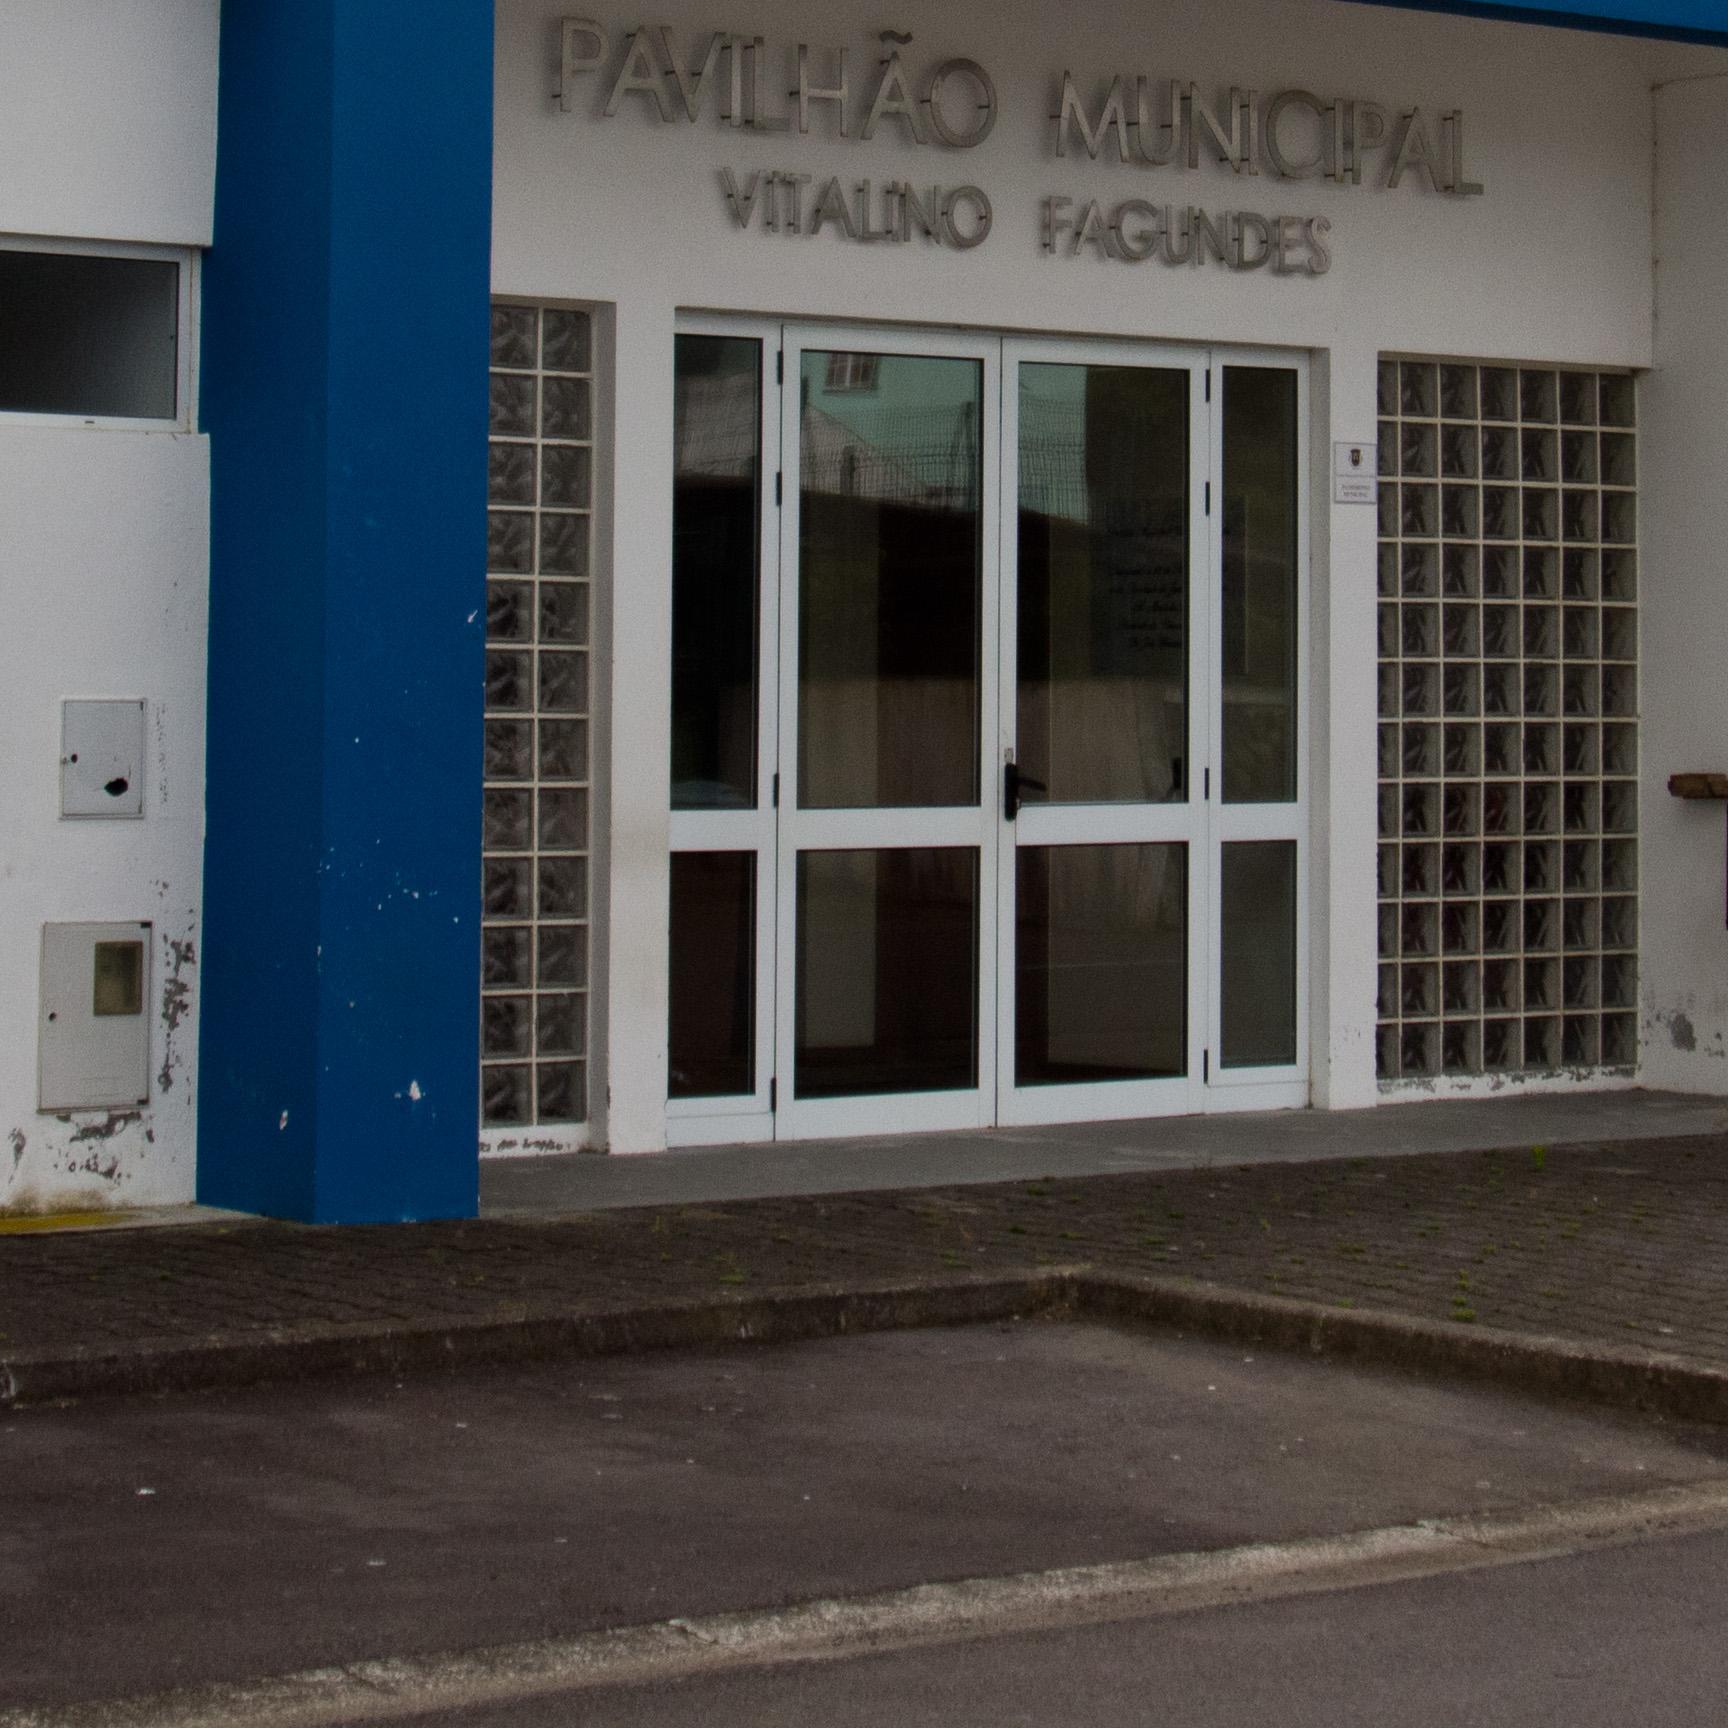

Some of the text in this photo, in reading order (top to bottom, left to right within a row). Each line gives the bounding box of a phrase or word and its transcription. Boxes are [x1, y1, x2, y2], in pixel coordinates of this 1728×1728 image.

[557, 17, 1484, 197] PAVILHÃO MUNICIPAL
[722, 166, 1332, 275] VITALINO FAGUNDES
